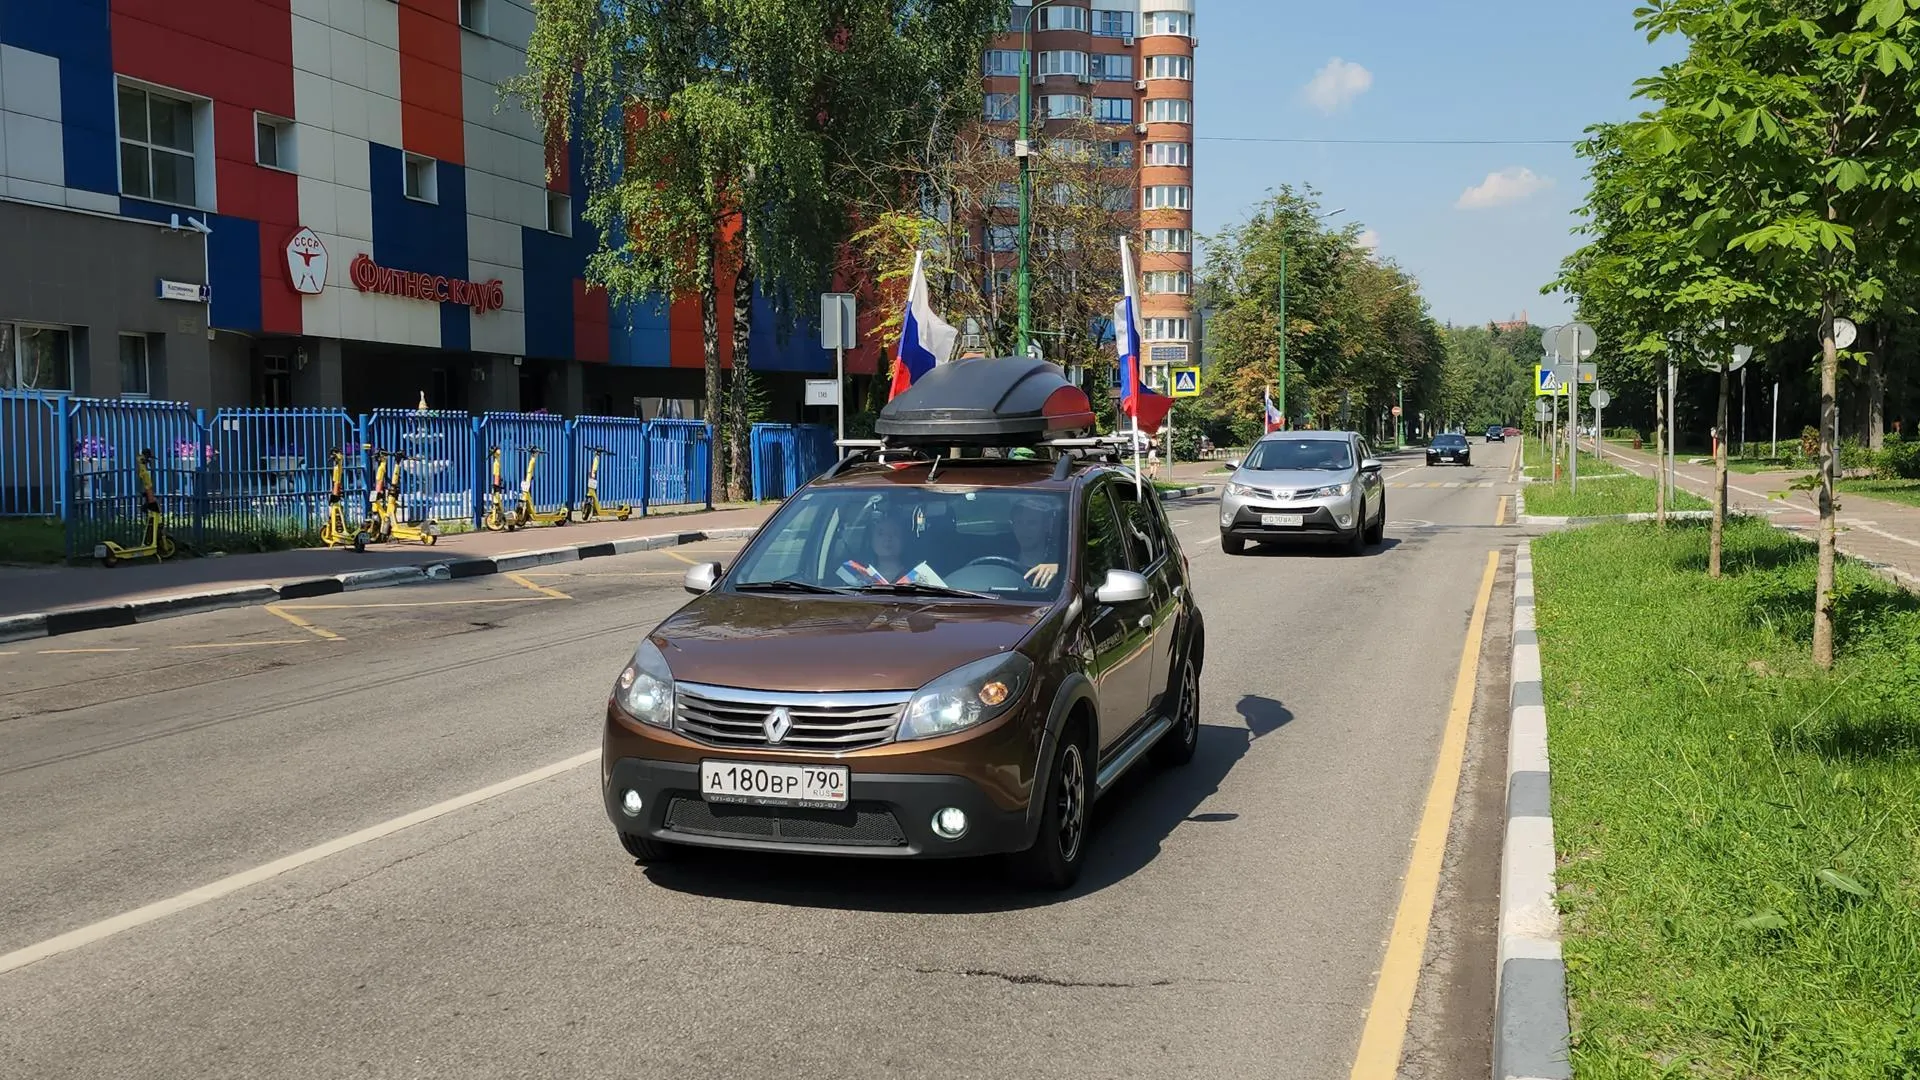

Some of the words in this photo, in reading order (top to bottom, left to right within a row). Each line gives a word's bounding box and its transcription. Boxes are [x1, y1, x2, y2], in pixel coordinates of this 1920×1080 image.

[294, 236, 319, 249] СССР
[350, 253, 449, 302] Фитнес
[449, 278, 504, 315] клуб
[804, 770, 840, 790] 790
[813, 789, 831, 798] RUS
